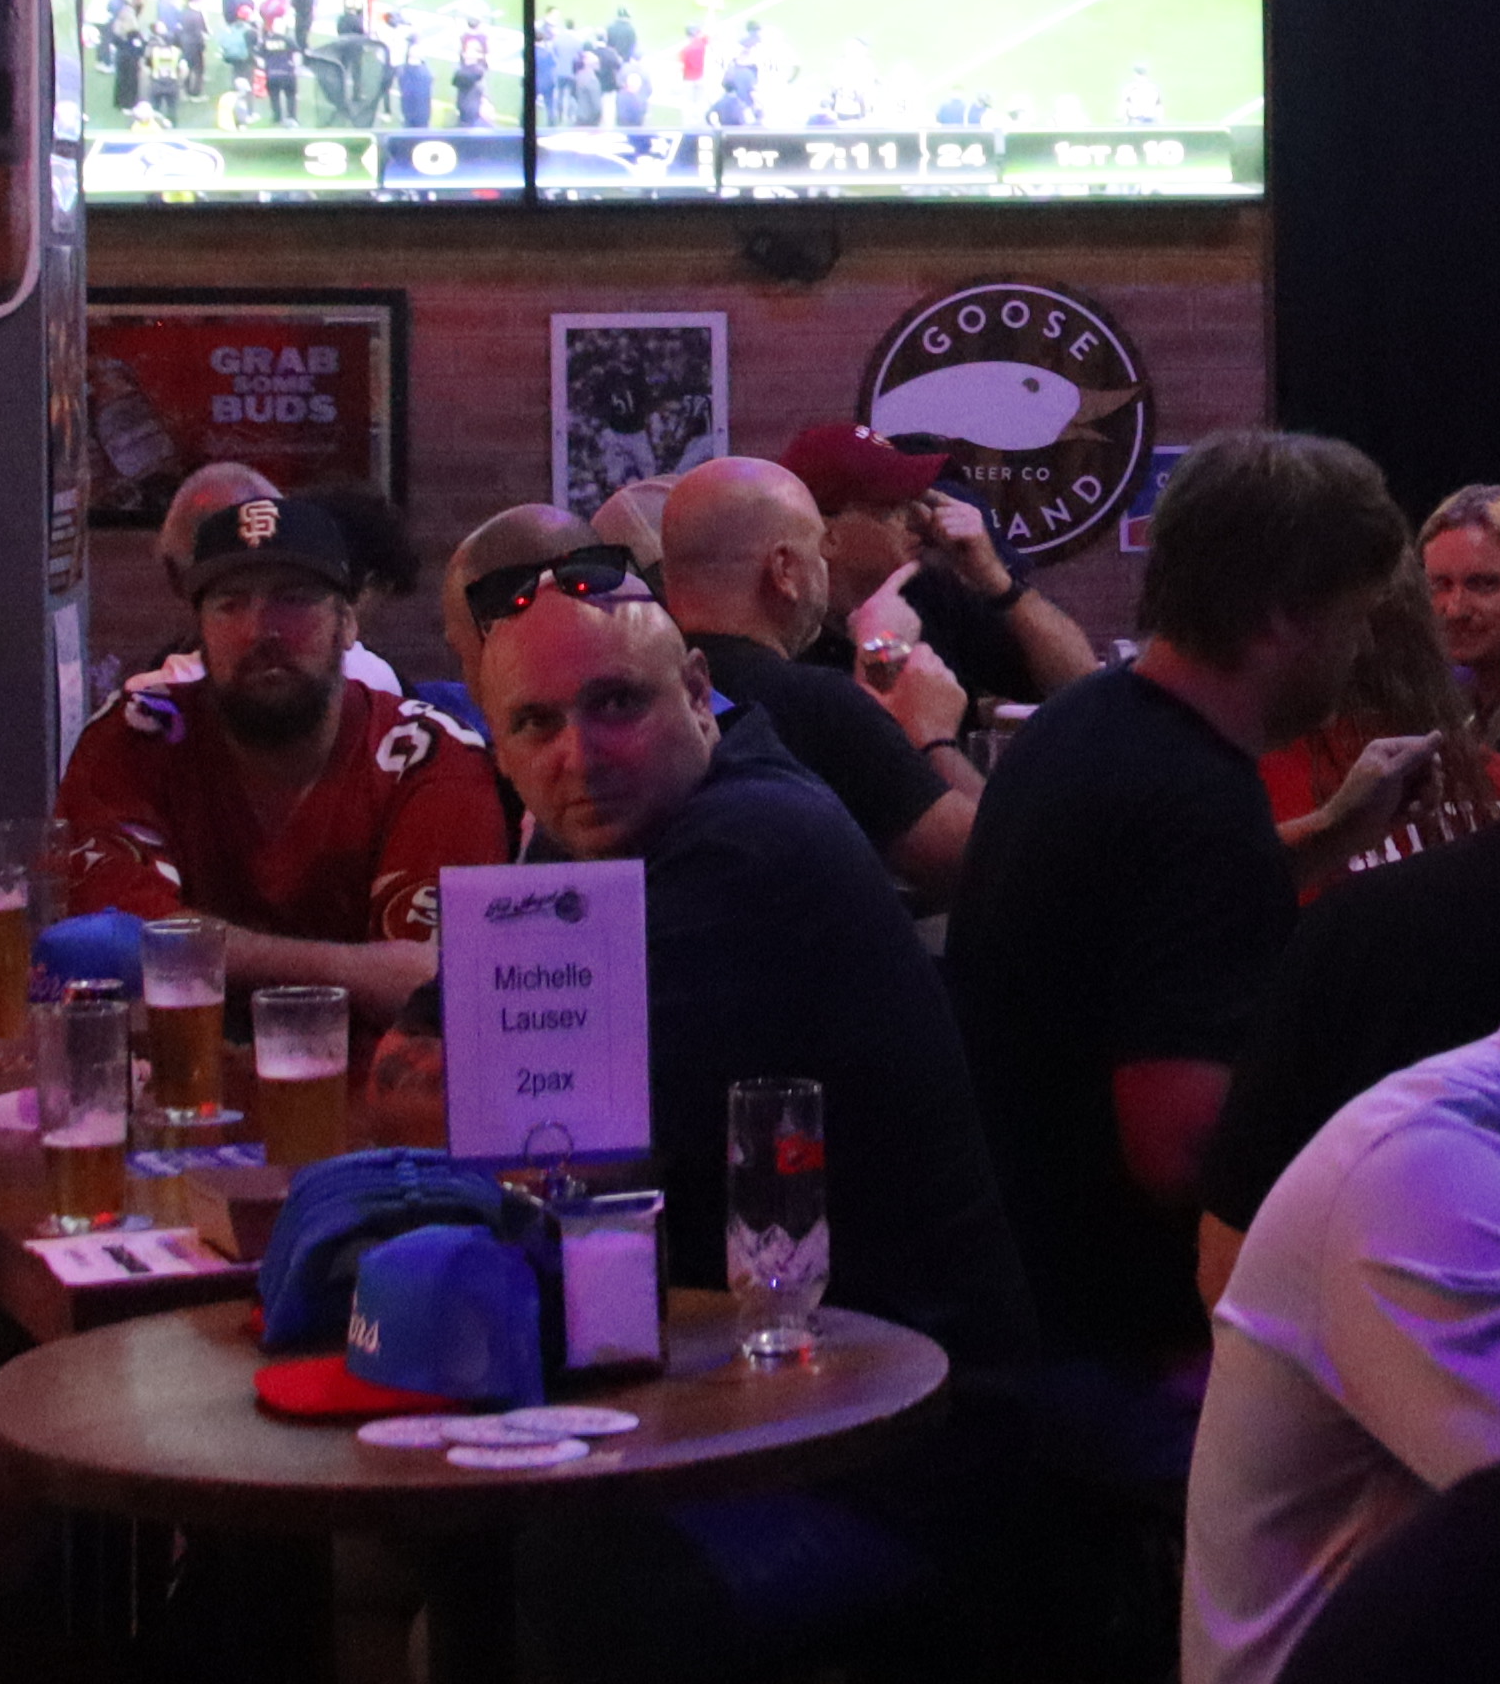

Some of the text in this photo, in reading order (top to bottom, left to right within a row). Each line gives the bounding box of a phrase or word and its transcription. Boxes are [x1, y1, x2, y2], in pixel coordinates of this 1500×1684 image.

[304, 141, 347, 176] 3
[411, 140, 457, 176] 0
[805, 142, 897, 170] 7:11
[936, 143, 987, 168] 24
[1142, 139, 1185, 167] 10
[921, 299, 1100, 362] GOOSE
[209, 345, 341, 375] GRAB
[231, 374, 317, 394] SOME
[210, 393, 339, 424] BUDS
[1021, 466, 1051, 482] CO
[494, 962, 593, 992] Michelle
[516, 1067, 574, 1098] 2pax
